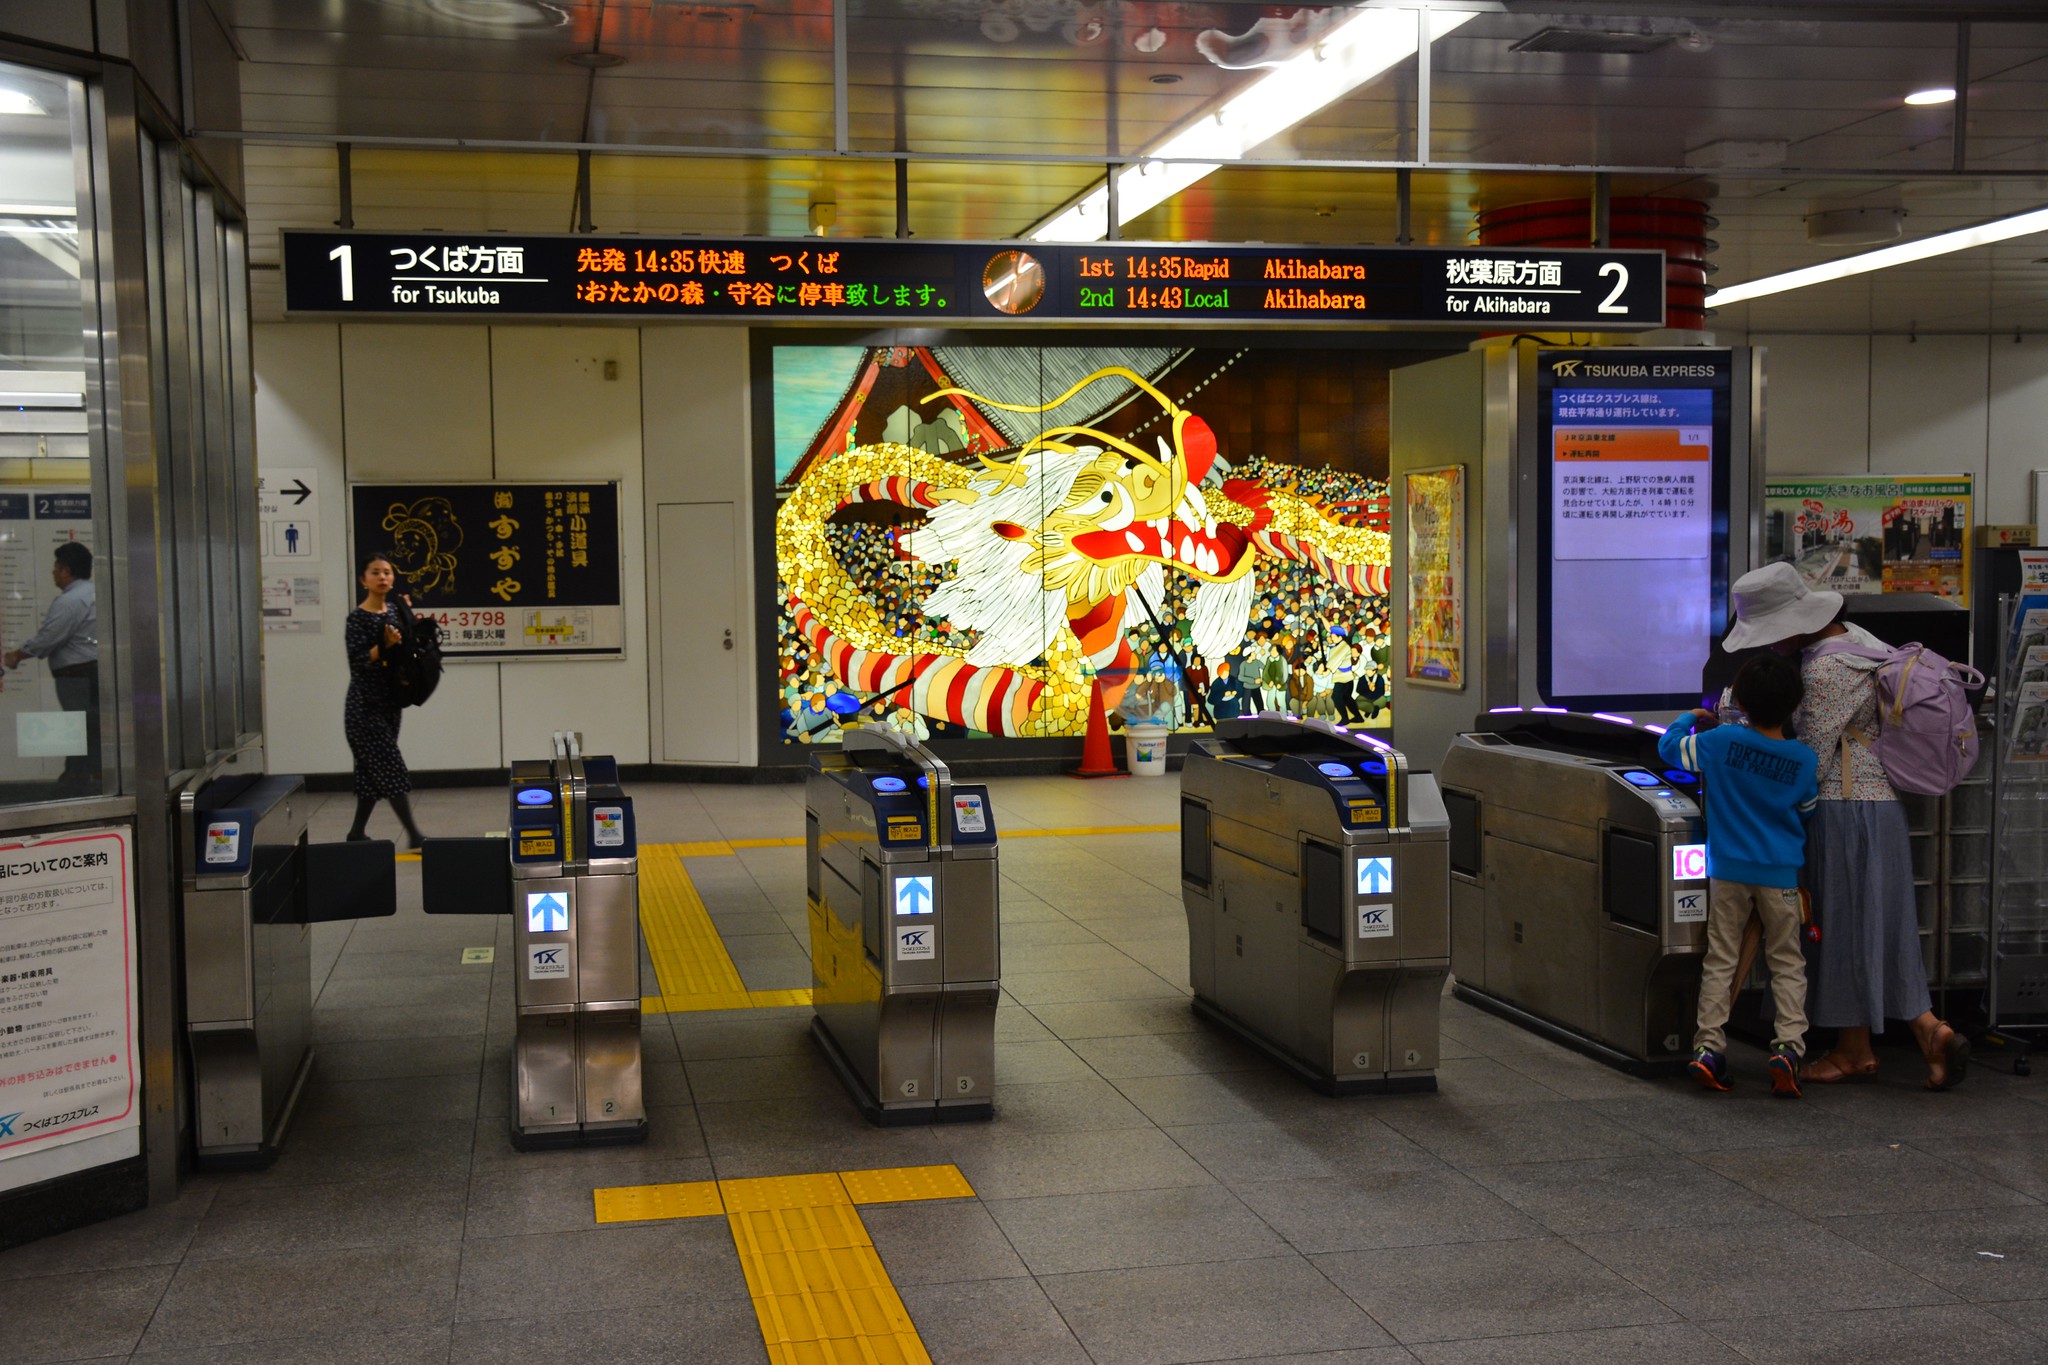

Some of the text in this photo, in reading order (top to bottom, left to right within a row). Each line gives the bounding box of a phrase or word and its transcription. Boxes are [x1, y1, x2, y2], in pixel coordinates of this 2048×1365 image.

[390, 246, 524, 274] つくば方面
[577, 248, 838, 275] 先発 14:35 快速 つくば
[328, 245, 354, 301] 1
[1079, 256, 1365, 282] 1st 14:35 Rapid Akihabara
[1446, 258, 1562, 287] 秋葉原方面
[392, 284, 500, 304] for Tsukuba
[577, 281, 947, 309] おたかの森・守谷に停車致します。
[1597, 262, 1630, 314] 2
[1079, 287, 1365, 311] 2nd 14:43 Local Akihabara
[1446, 294, 1551, 314] for Akihabara
[1552, 359, 1715, 377] TX TSUKUBA EXPRESS
[1559, 393, 1662, 405] つくばエクスプレス線は、
[1558, 407, 1680, 418] 現在平常通り運行しています。
[1688, 434, 1699, 442] 1/1
[39, 499, 50, 514] 2
[570, 514, 588, 568] 小道具
[1727, 740, 1803, 777] FORTITUDE
[1724, 757, 1799, 786] AND PROGRESS
[1675, 849, 1704, 877] IC
[1678, 895, 1702, 909] TX
[1363, 909, 1388, 924] TX
[901, 930, 929, 945] TX
[533, 949, 564, 964] TX
[0, 1025, 22, 1037] 小動物
[1669, 1037, 1676, 1047] 4
[1358, 1055, 1366, 1066] 3
[1407, 1052, 1415, 1063] 4
[907, 1083, 915, 1093] 2
[960, 1079, 968, 1090] 3
[549, 1106, 555, 1116] 1
[605, 1101, 614, 1113] 2
[24, 1106, 99, 1132] つくばエクスプレス
[223, 1127, 229, 1137] 1
